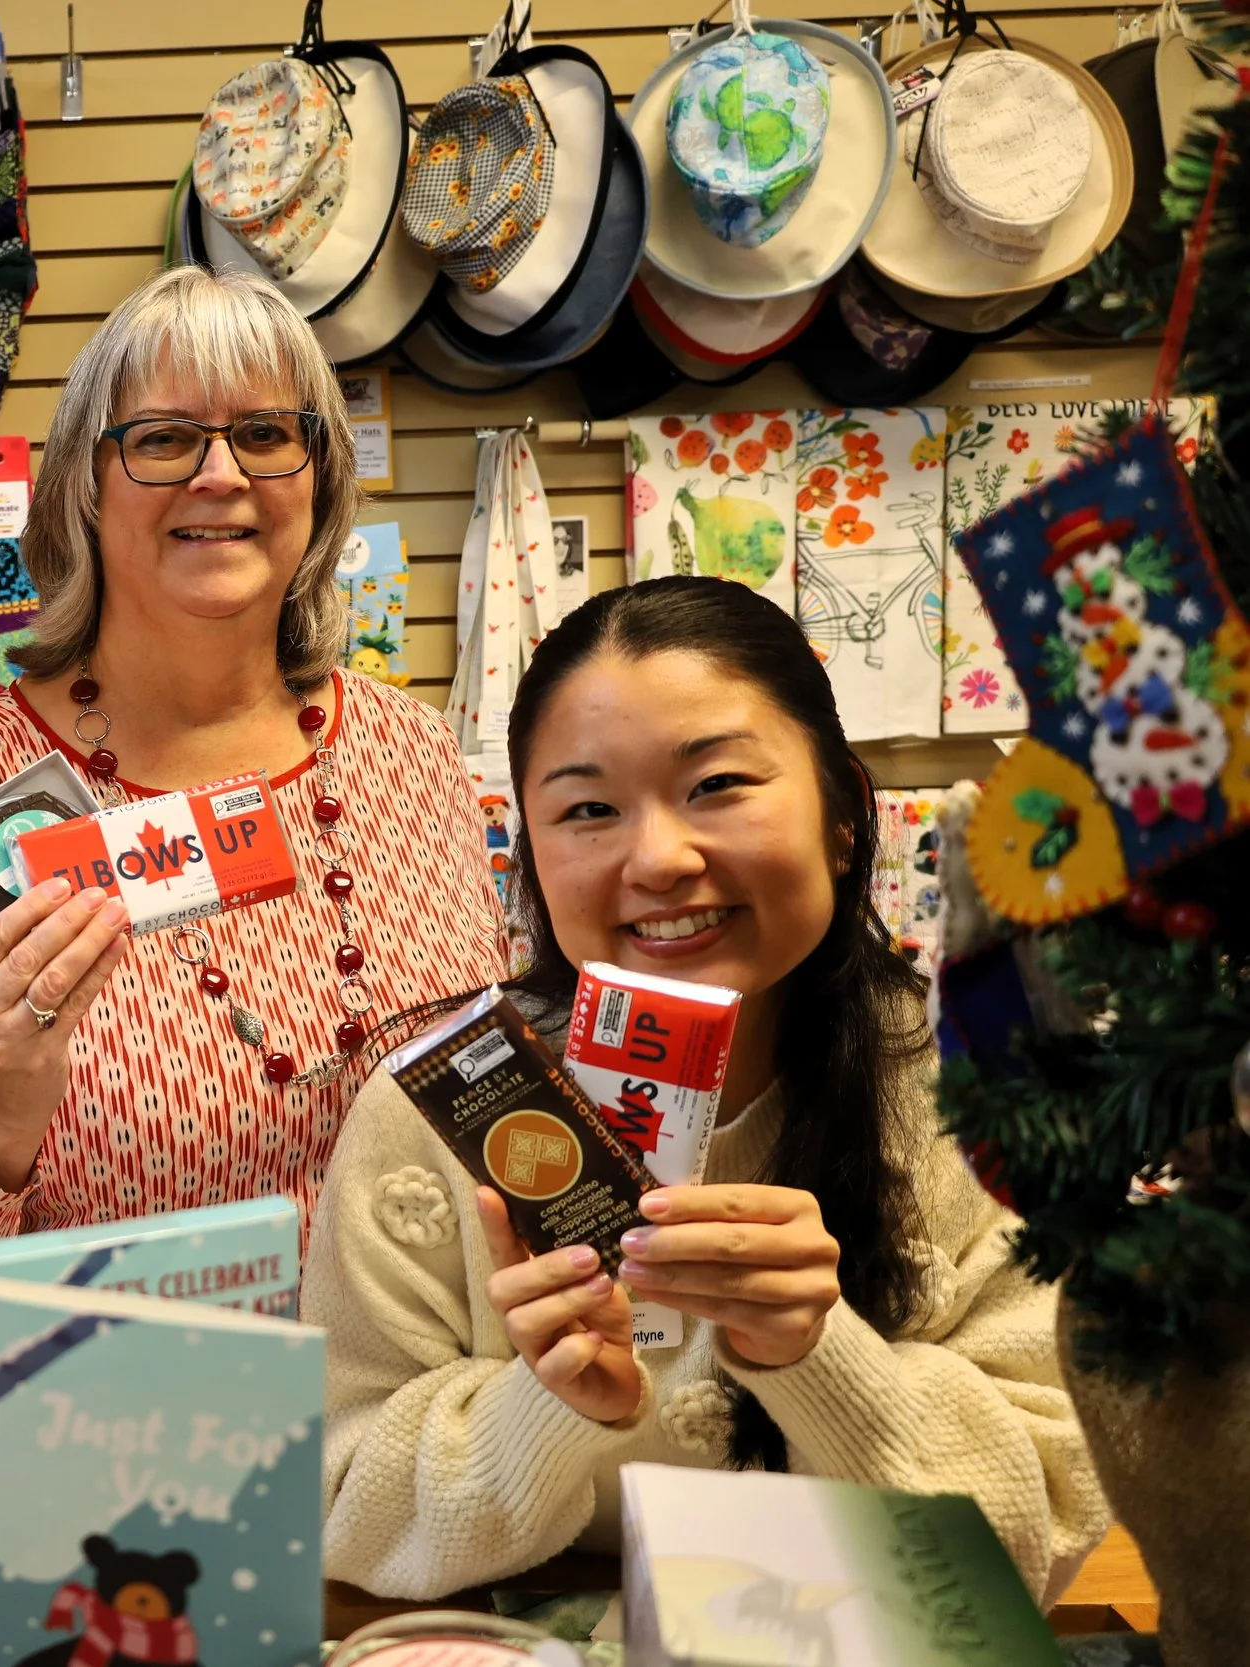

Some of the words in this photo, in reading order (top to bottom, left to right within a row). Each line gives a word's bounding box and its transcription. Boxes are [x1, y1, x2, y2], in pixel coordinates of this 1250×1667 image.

[214, 819, 258, 854] UP
[144, 916, 161, 928] BY
[629, 1011, 670, 1063] UP
[493, 1068, 508, 1082] BY
[540, 1179, 599, 1218] cappuccino
[540, 1213, 561, 1232] milk
[563, 1184, 613, 1218] chocolate
[554, 1196, 614, 1236] cappuccino
[553, 1219, 598, 1249] chocolat
[598, 1211, 613, 1225] au
[613, 1200, 630, 1214] lait
[158, 1253, 283, 1300] CELEBRATE
[633, 1330, 664, 1345] ntyne
[37, 1391, 163, 1456] Just
[187, 1413, 289, 1471] For
[105, 1452, 231, 1524] You
